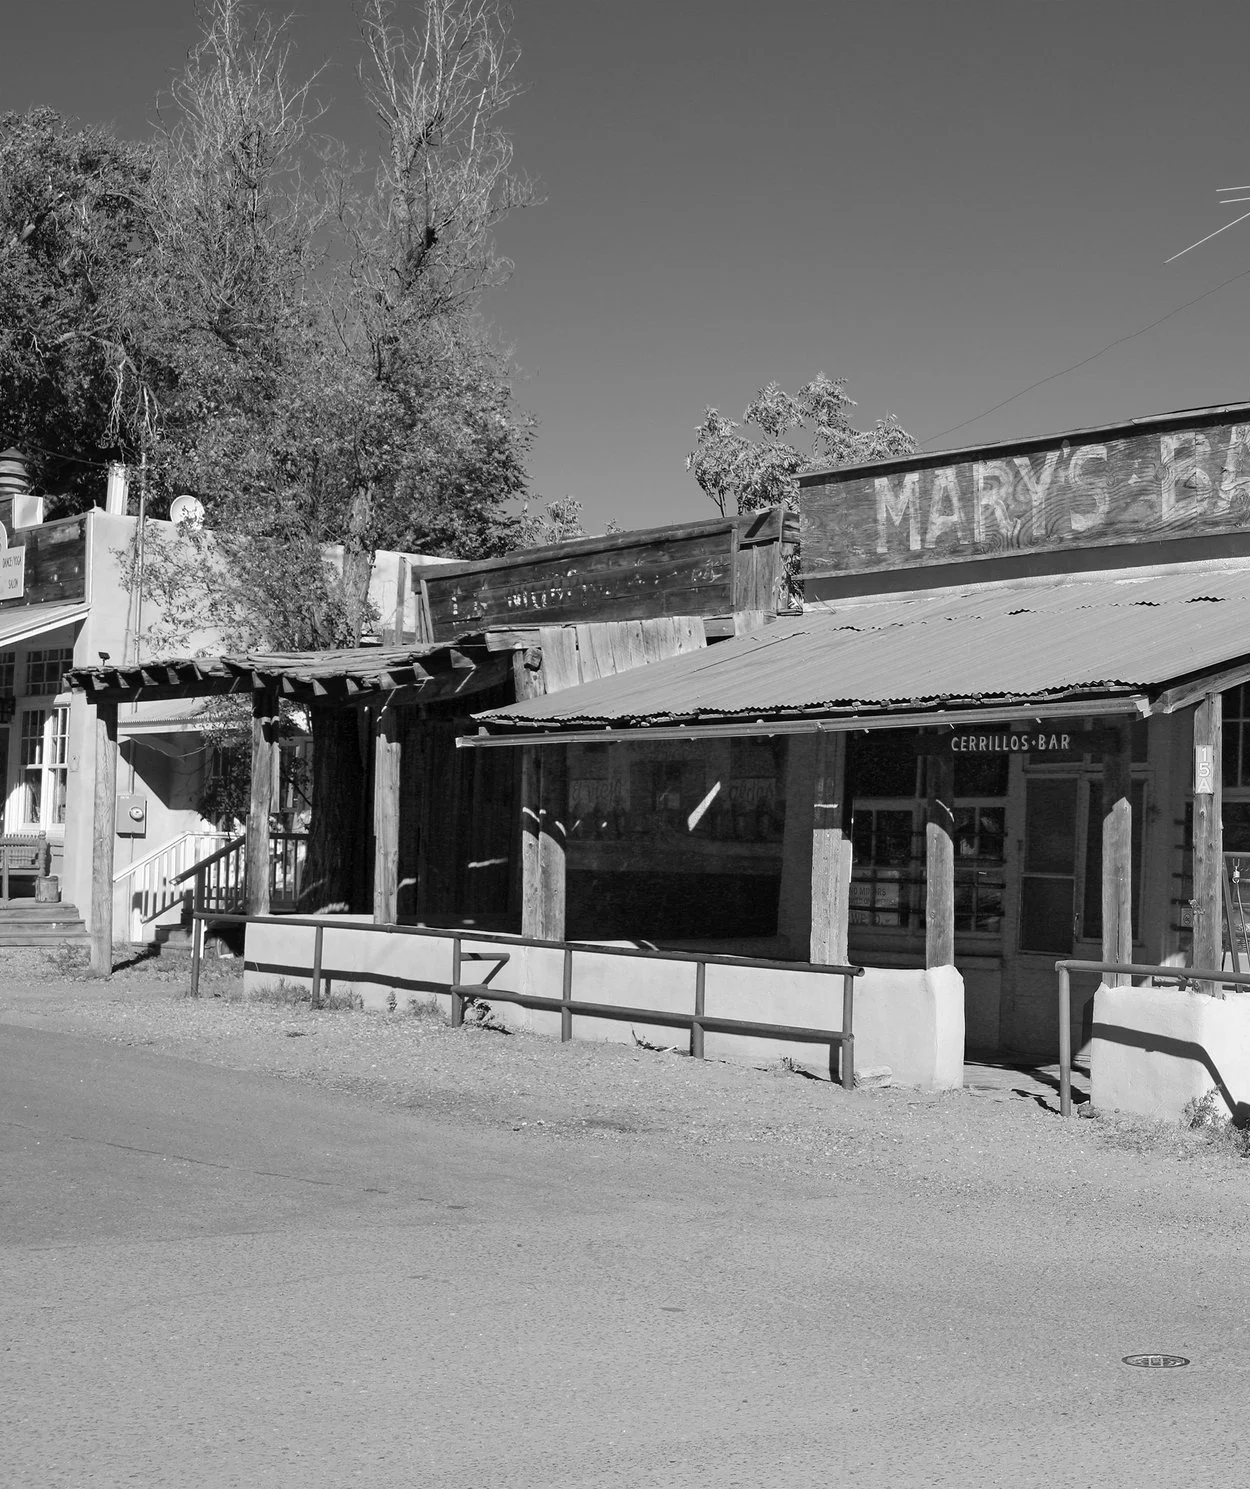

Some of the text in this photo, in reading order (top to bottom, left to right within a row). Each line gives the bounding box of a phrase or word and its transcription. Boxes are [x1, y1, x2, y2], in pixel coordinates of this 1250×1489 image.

[873, 439, 1108, 554] MARY'S
[951, 734, 1070, 751] CERRILLOS BAR
[859, 887, 887, 896] MINRS
